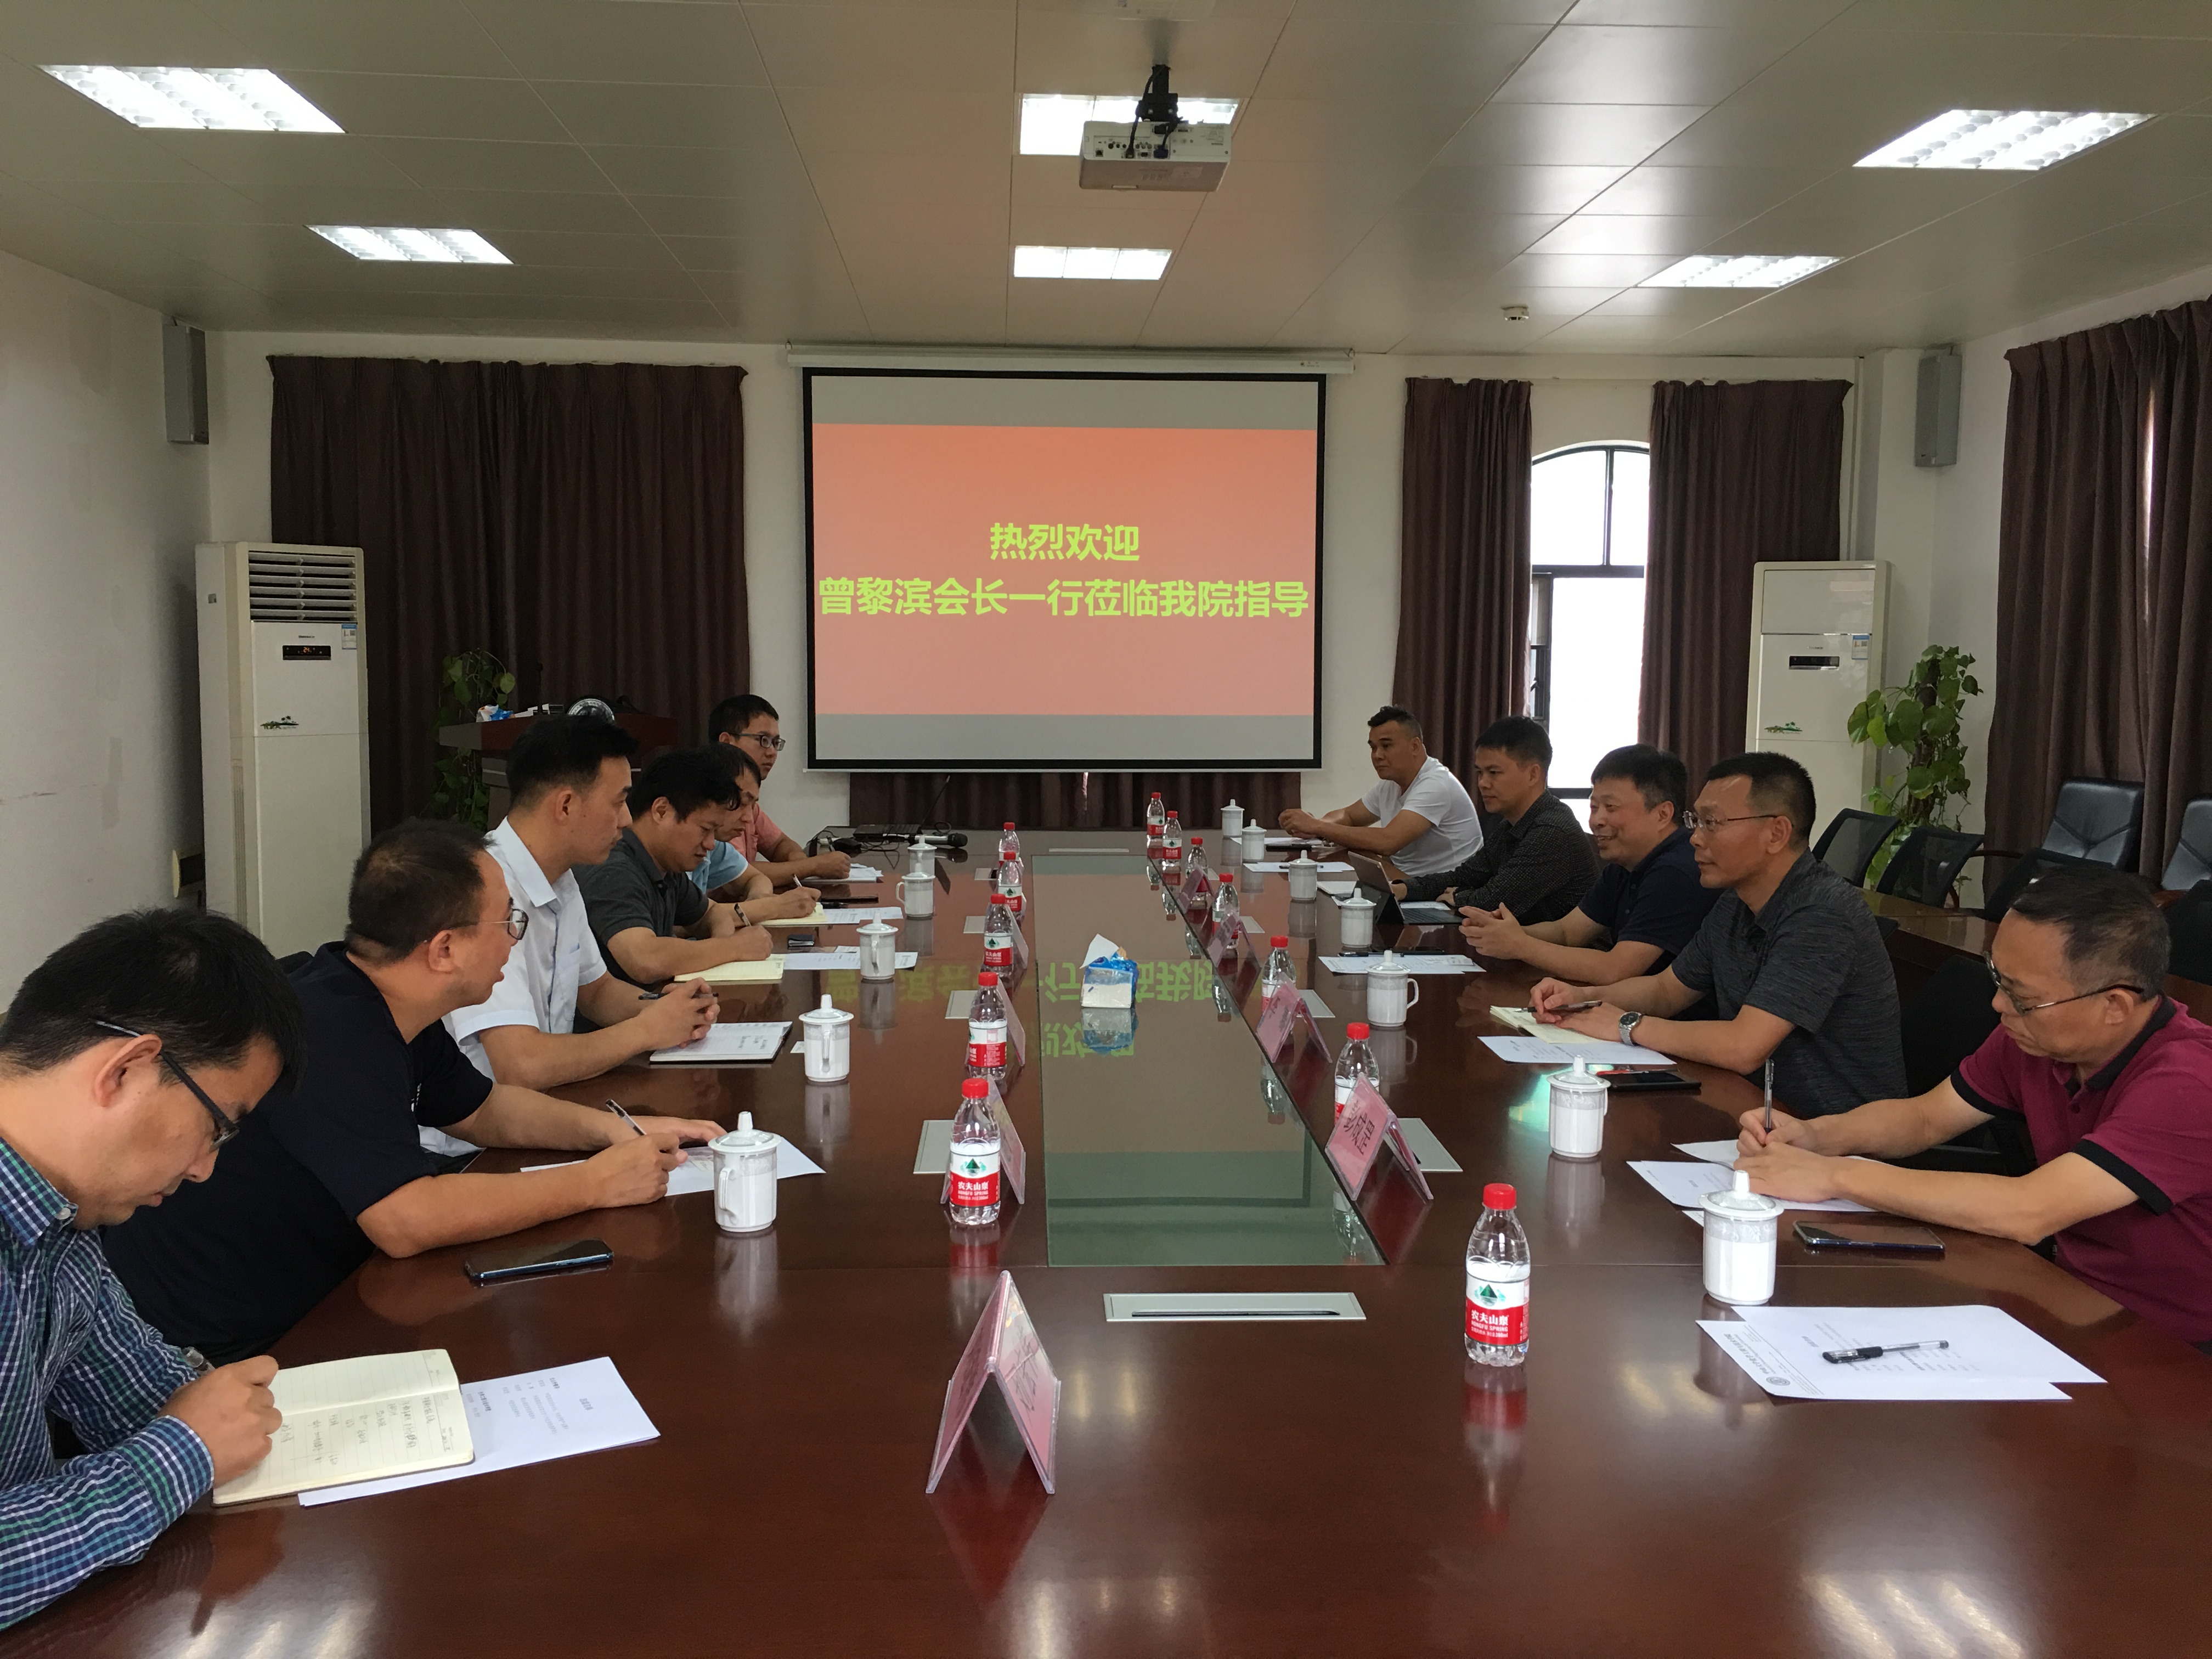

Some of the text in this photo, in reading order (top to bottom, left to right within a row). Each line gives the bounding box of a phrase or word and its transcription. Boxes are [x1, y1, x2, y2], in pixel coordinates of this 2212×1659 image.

[990, 523, 1140, 561] 热烈欢迎
[819, 577, 1309, 617] 曾黎滨会长一行莅临我院指导
[1344, 1100, 1375, 1155] 彭成罡
[958, 1181, 989, 1190] 农夫山泉
[1471, 1310, 1509, 1325] 农夫山泉
